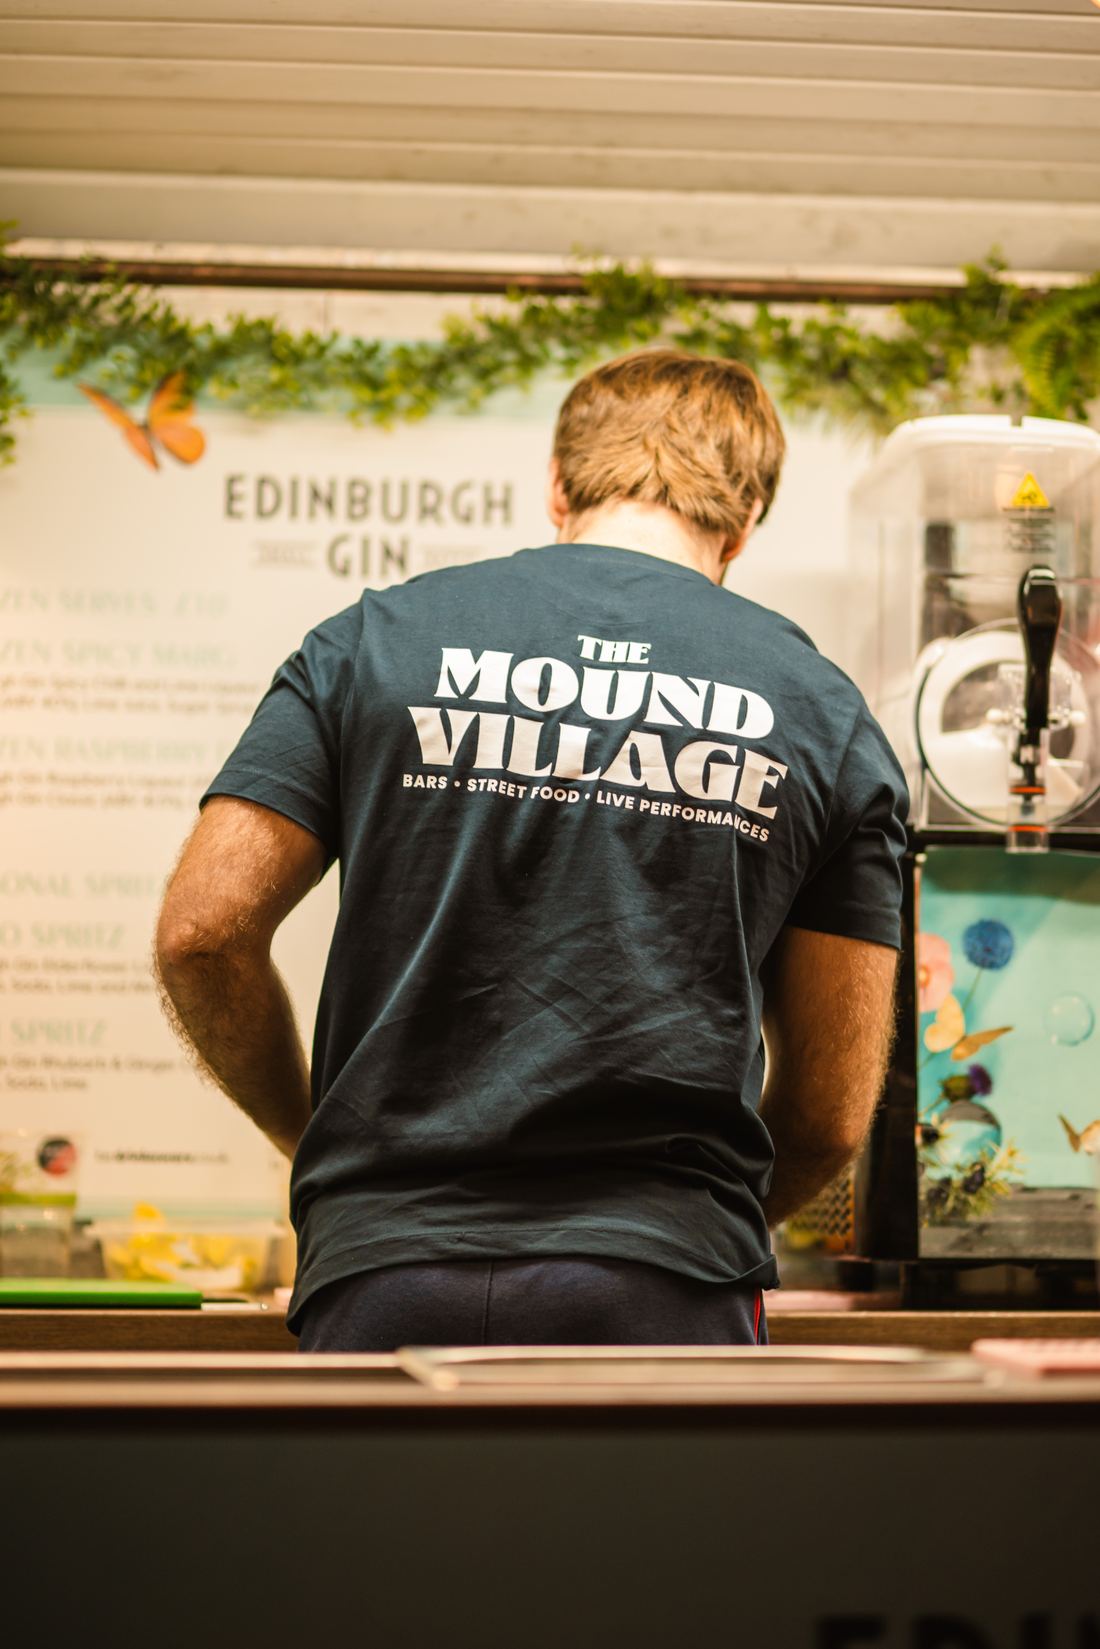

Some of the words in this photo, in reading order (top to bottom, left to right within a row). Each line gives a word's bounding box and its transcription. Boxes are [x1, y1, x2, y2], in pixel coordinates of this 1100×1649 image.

[223, 473, 515, 526] EDINBURGH
[327, 533, 411, 580] GIN
[577, 634, 652, 664] THE
[434, 647, 775, 739] MOUND
[407, 706, 789, 820] VILLAGE
[402, 773, 448, 790] BARS
[467, 778, 527, 799] STREET
[530, 785, 580, 804] FOOD
[596, 790, 635, 810] LIVE
[639, 800, 770, 842] PERFORMANCES
[30, 921, 126, 949] SPRITZ
[10, 1016, 108, 1046] SPRITZ
